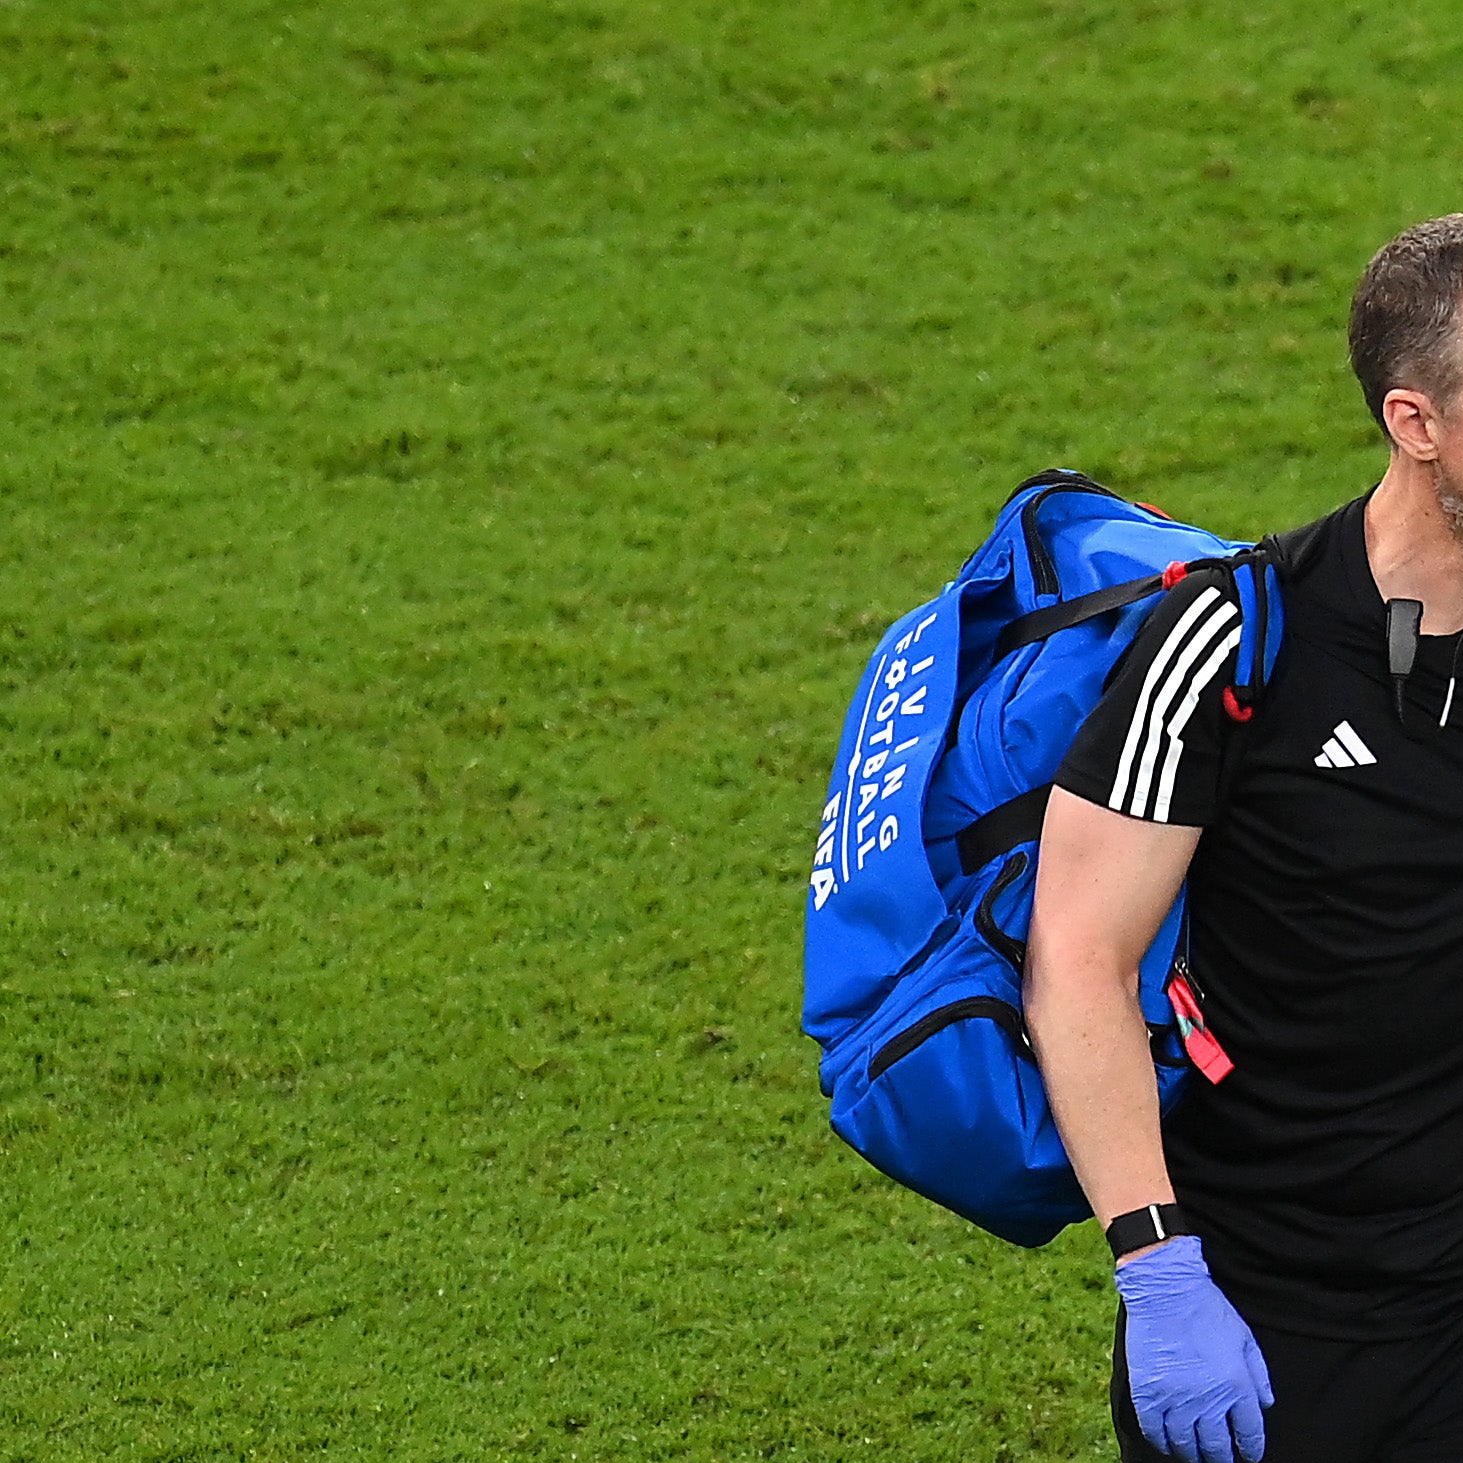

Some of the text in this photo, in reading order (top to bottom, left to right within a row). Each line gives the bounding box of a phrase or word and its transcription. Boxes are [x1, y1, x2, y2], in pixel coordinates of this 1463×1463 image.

[810, 791, 842, 911] FIFA
[857, 630, 914, 871] FOOTBALL
[879, 612, 937, 852] LIVING
